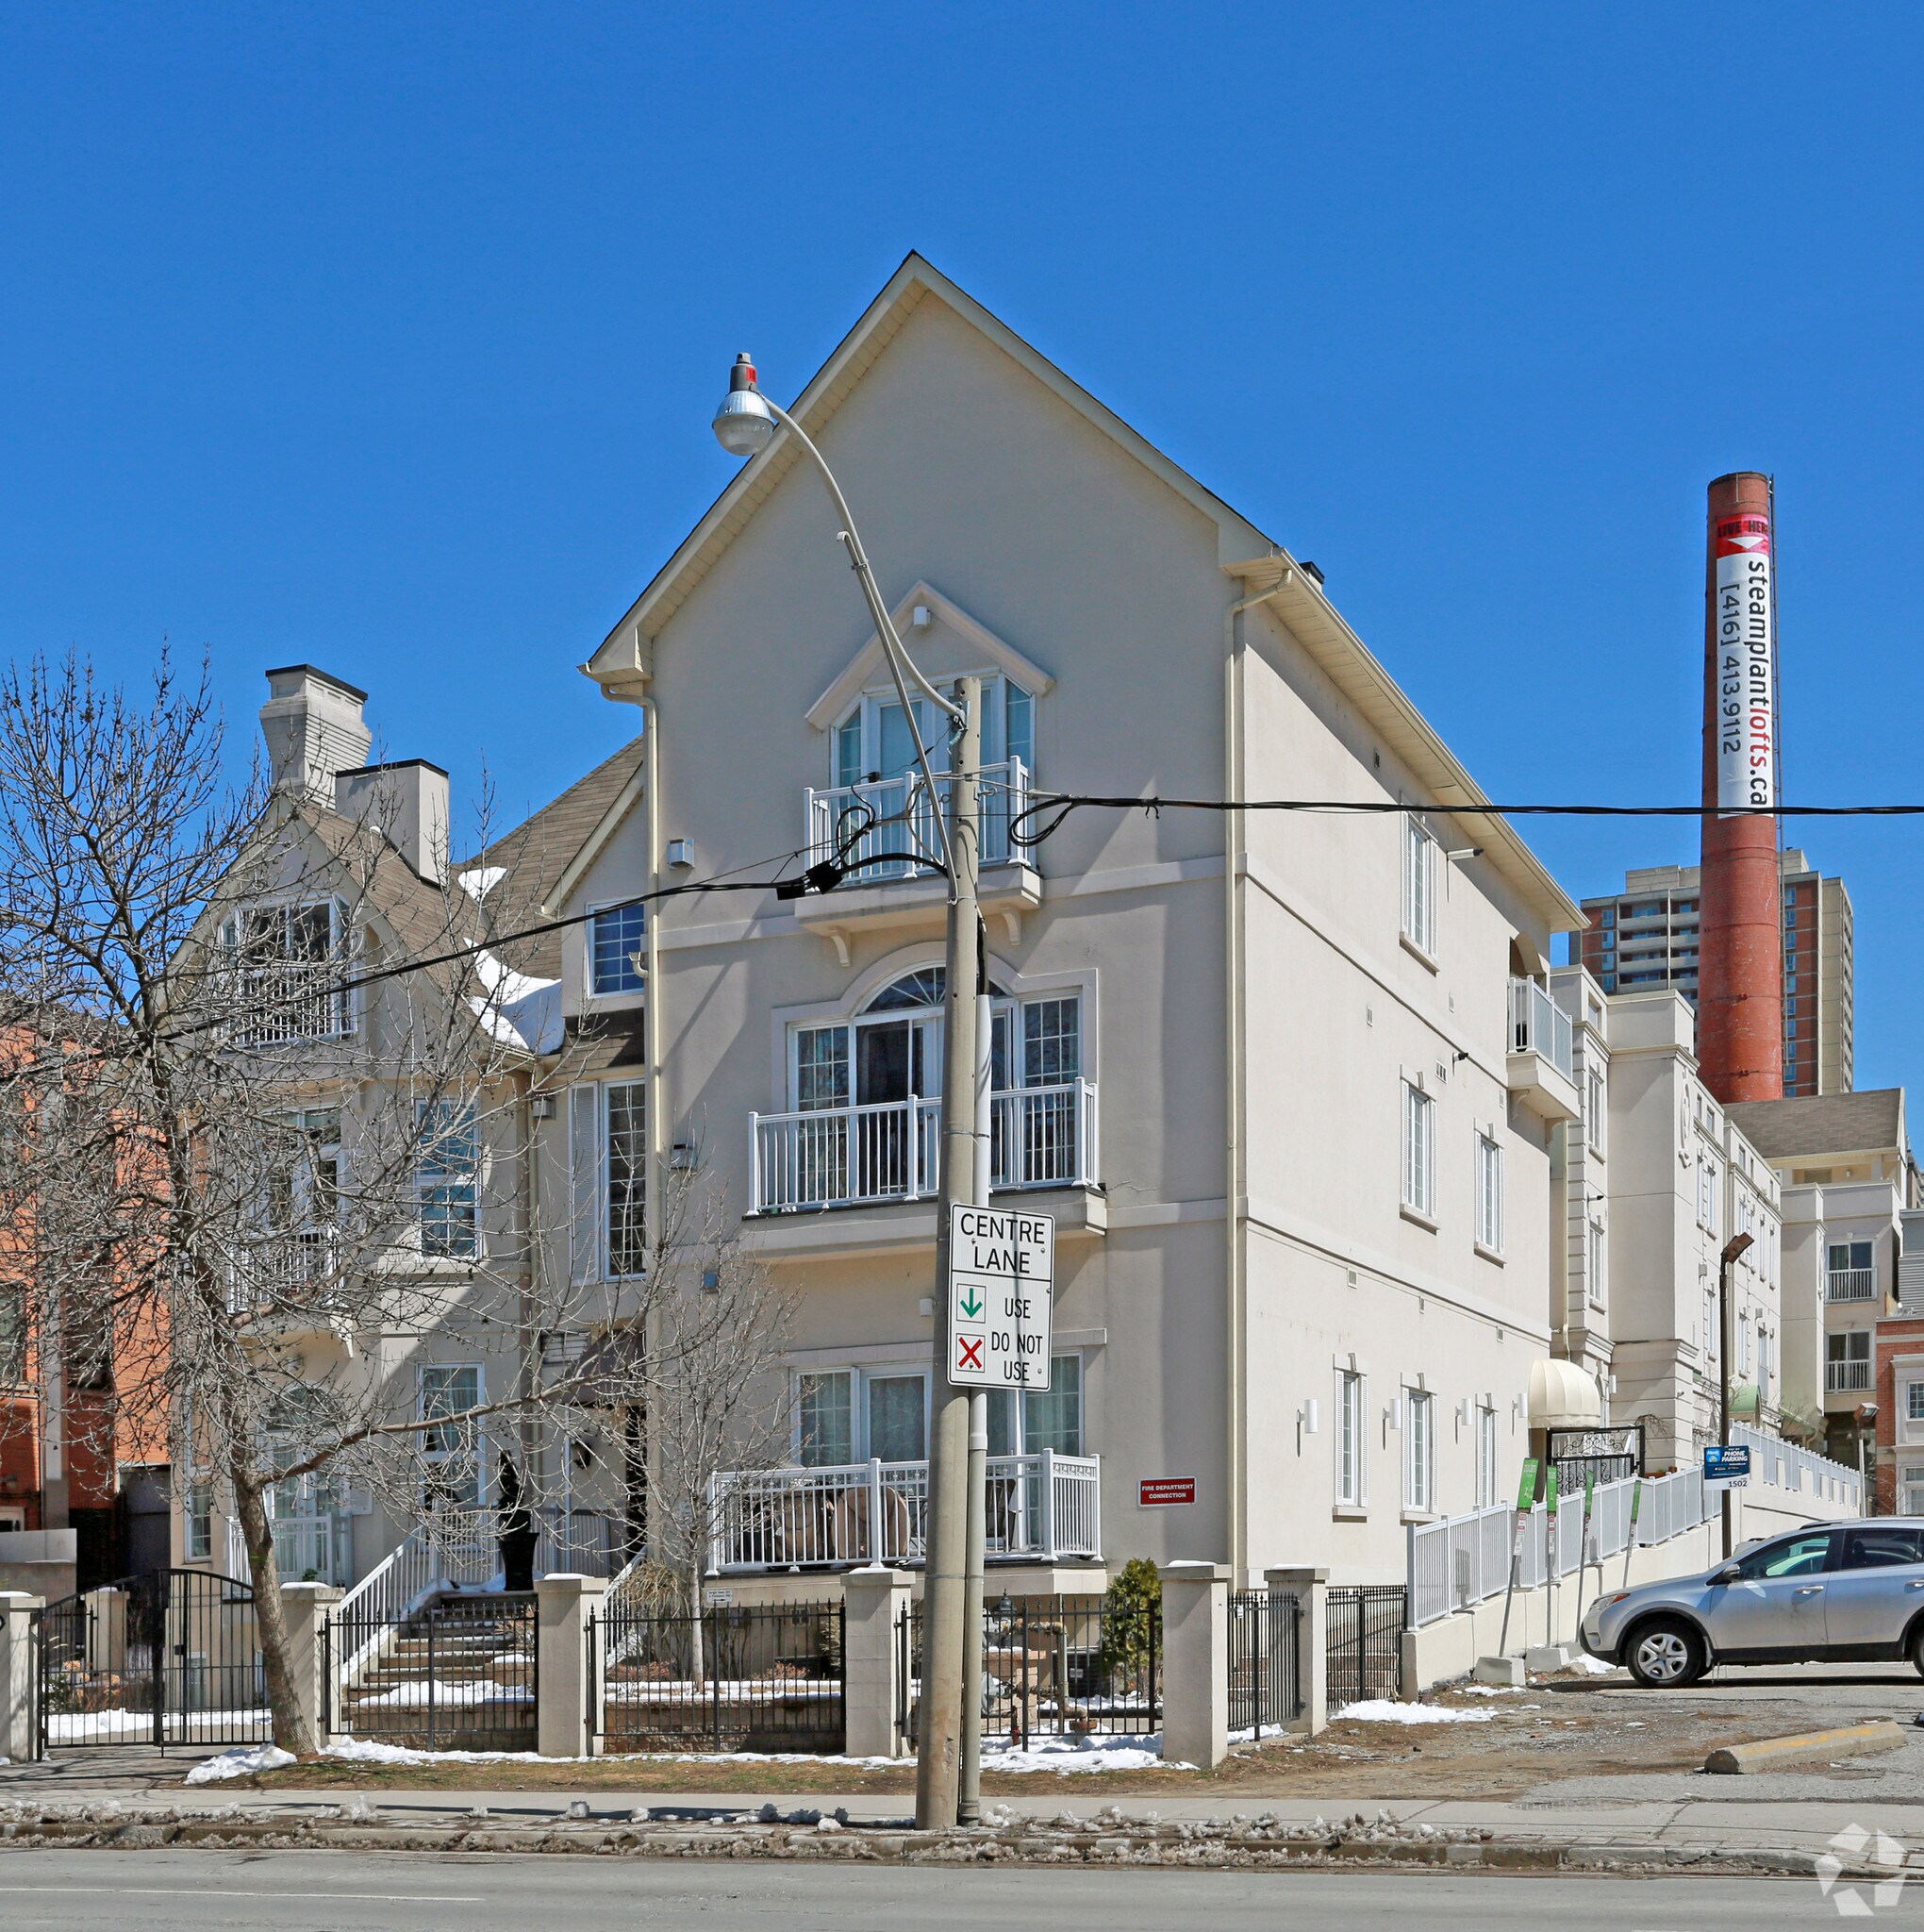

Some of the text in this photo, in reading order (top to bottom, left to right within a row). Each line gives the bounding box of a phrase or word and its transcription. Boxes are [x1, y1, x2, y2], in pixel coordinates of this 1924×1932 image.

[1717, 522, 1741, 538] LIVE
[1744, 559, 1769, 806] steamplantlofts.ca
[1722, 656, 1741, 755] 413.9112
[961, 1213, 1045, 1244] CENTRE
[974, 1246, 1030, 1274] LANE
[1005, 1298, 1031, 1319] USE
[991, 1332, 1043, 1355] DO NOT
[1003, 1360, 1030, 1381] USE
